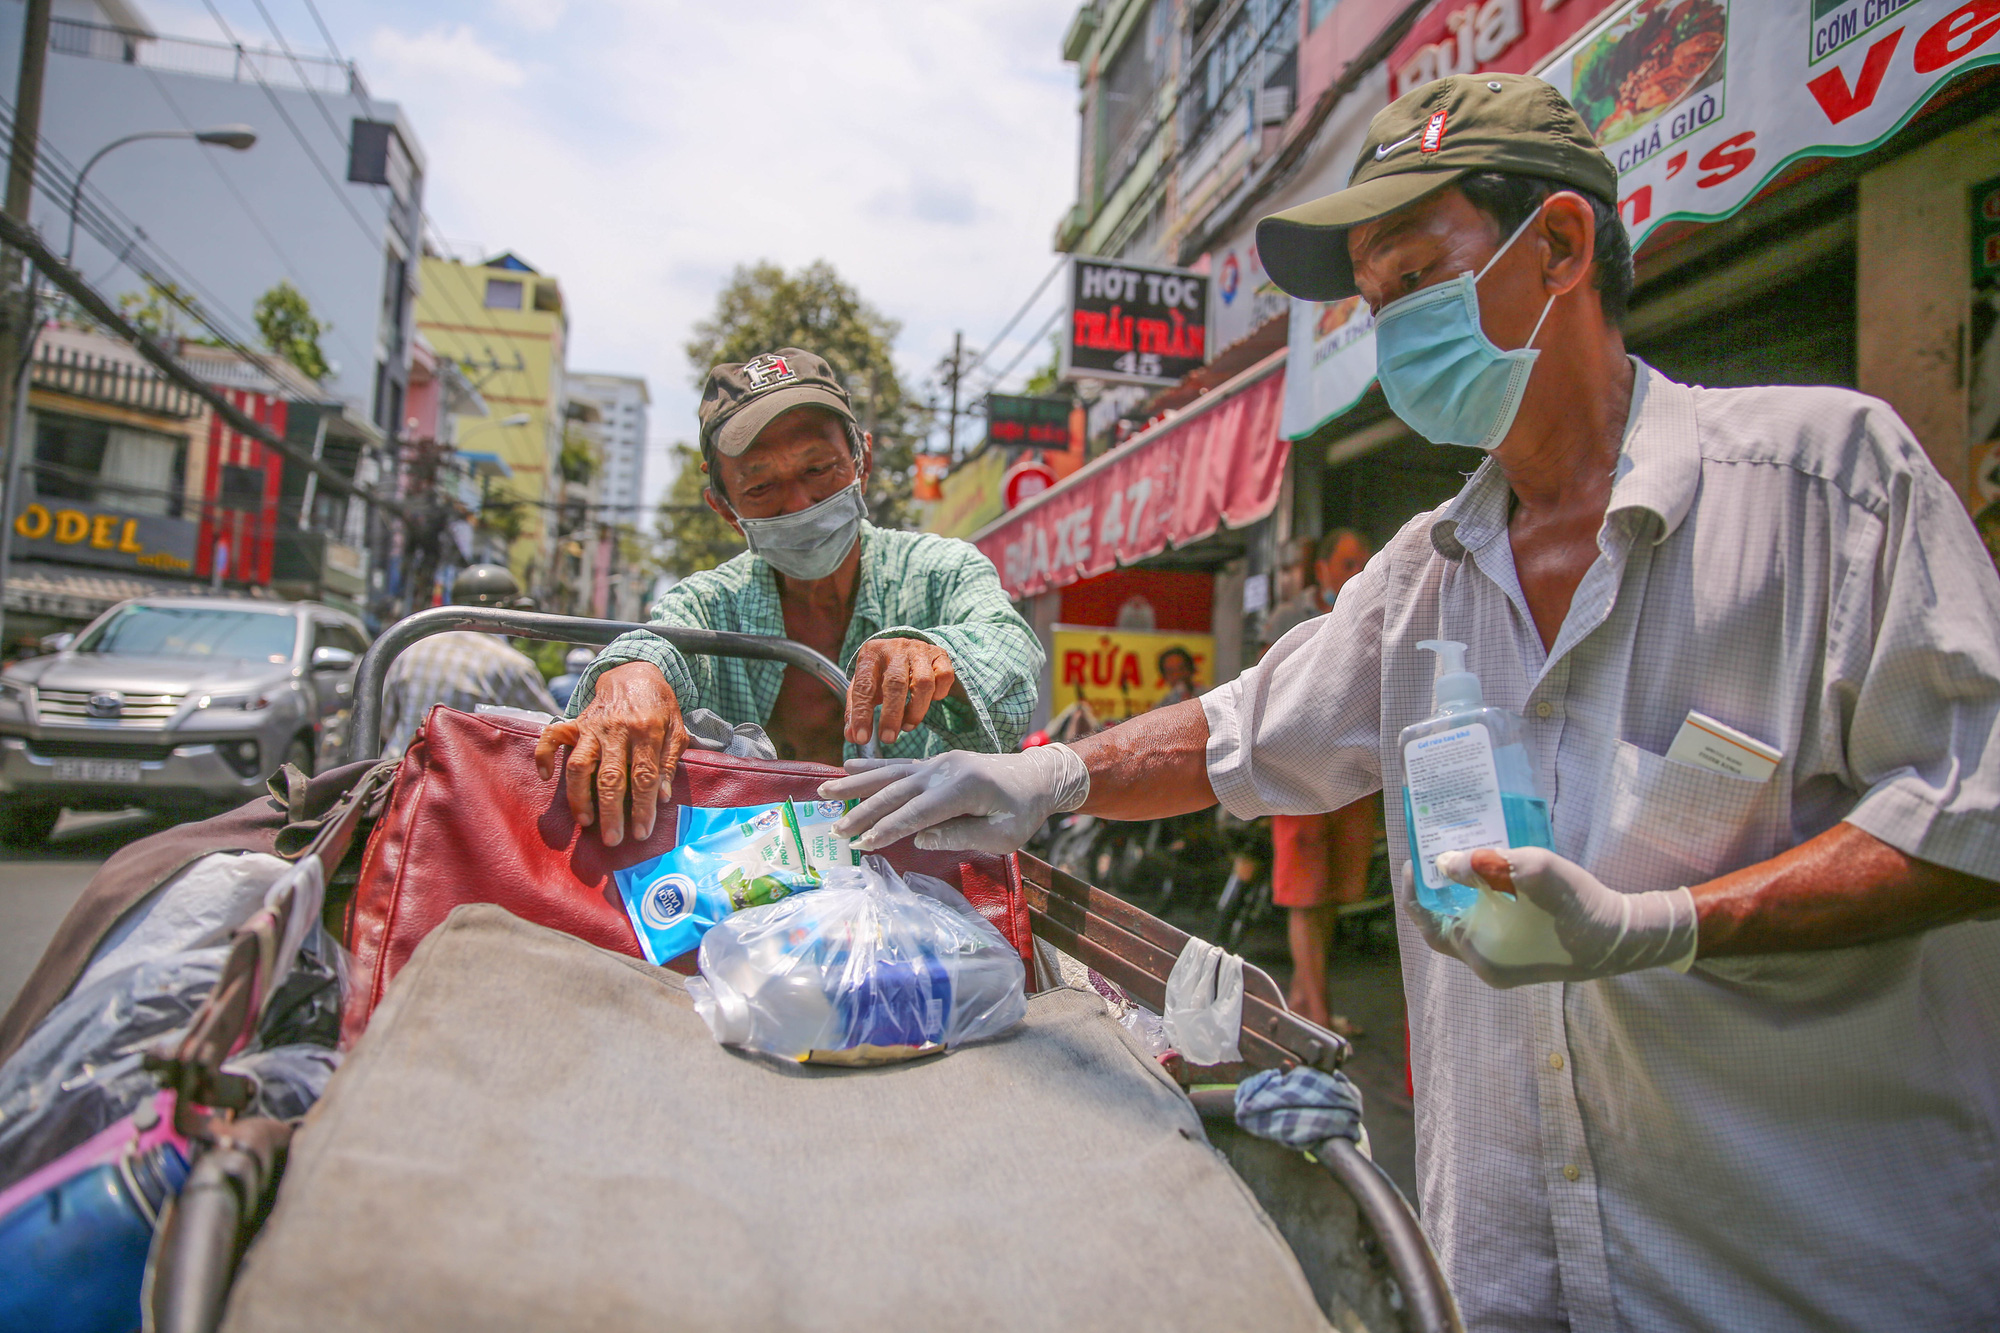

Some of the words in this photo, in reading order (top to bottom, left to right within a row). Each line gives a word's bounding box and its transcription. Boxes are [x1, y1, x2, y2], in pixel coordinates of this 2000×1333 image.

[1815, 8, 1858, 57] CƠM
[1863, 0, 1909, 28] CH
[1424, 114, 1444, 149] NIKE
[1671, 94, 1716, 140] GIÒ
[1073, 305, 1135, 352] THÁI
[743, 355, 798, 391] H
[1113, 351, 1163, 378] 45
[1052, 504, 1095, 572] XE
[1101, 475, 1153, 546] 47
[1063, 634, 1143, 689] RỬA
[815, 835, 825, 859] CANXI
[828, 831, 838, 861] PROTE
[657, 889, 677, 917] DUTCH
[664, 888, 682, 909] LADY
